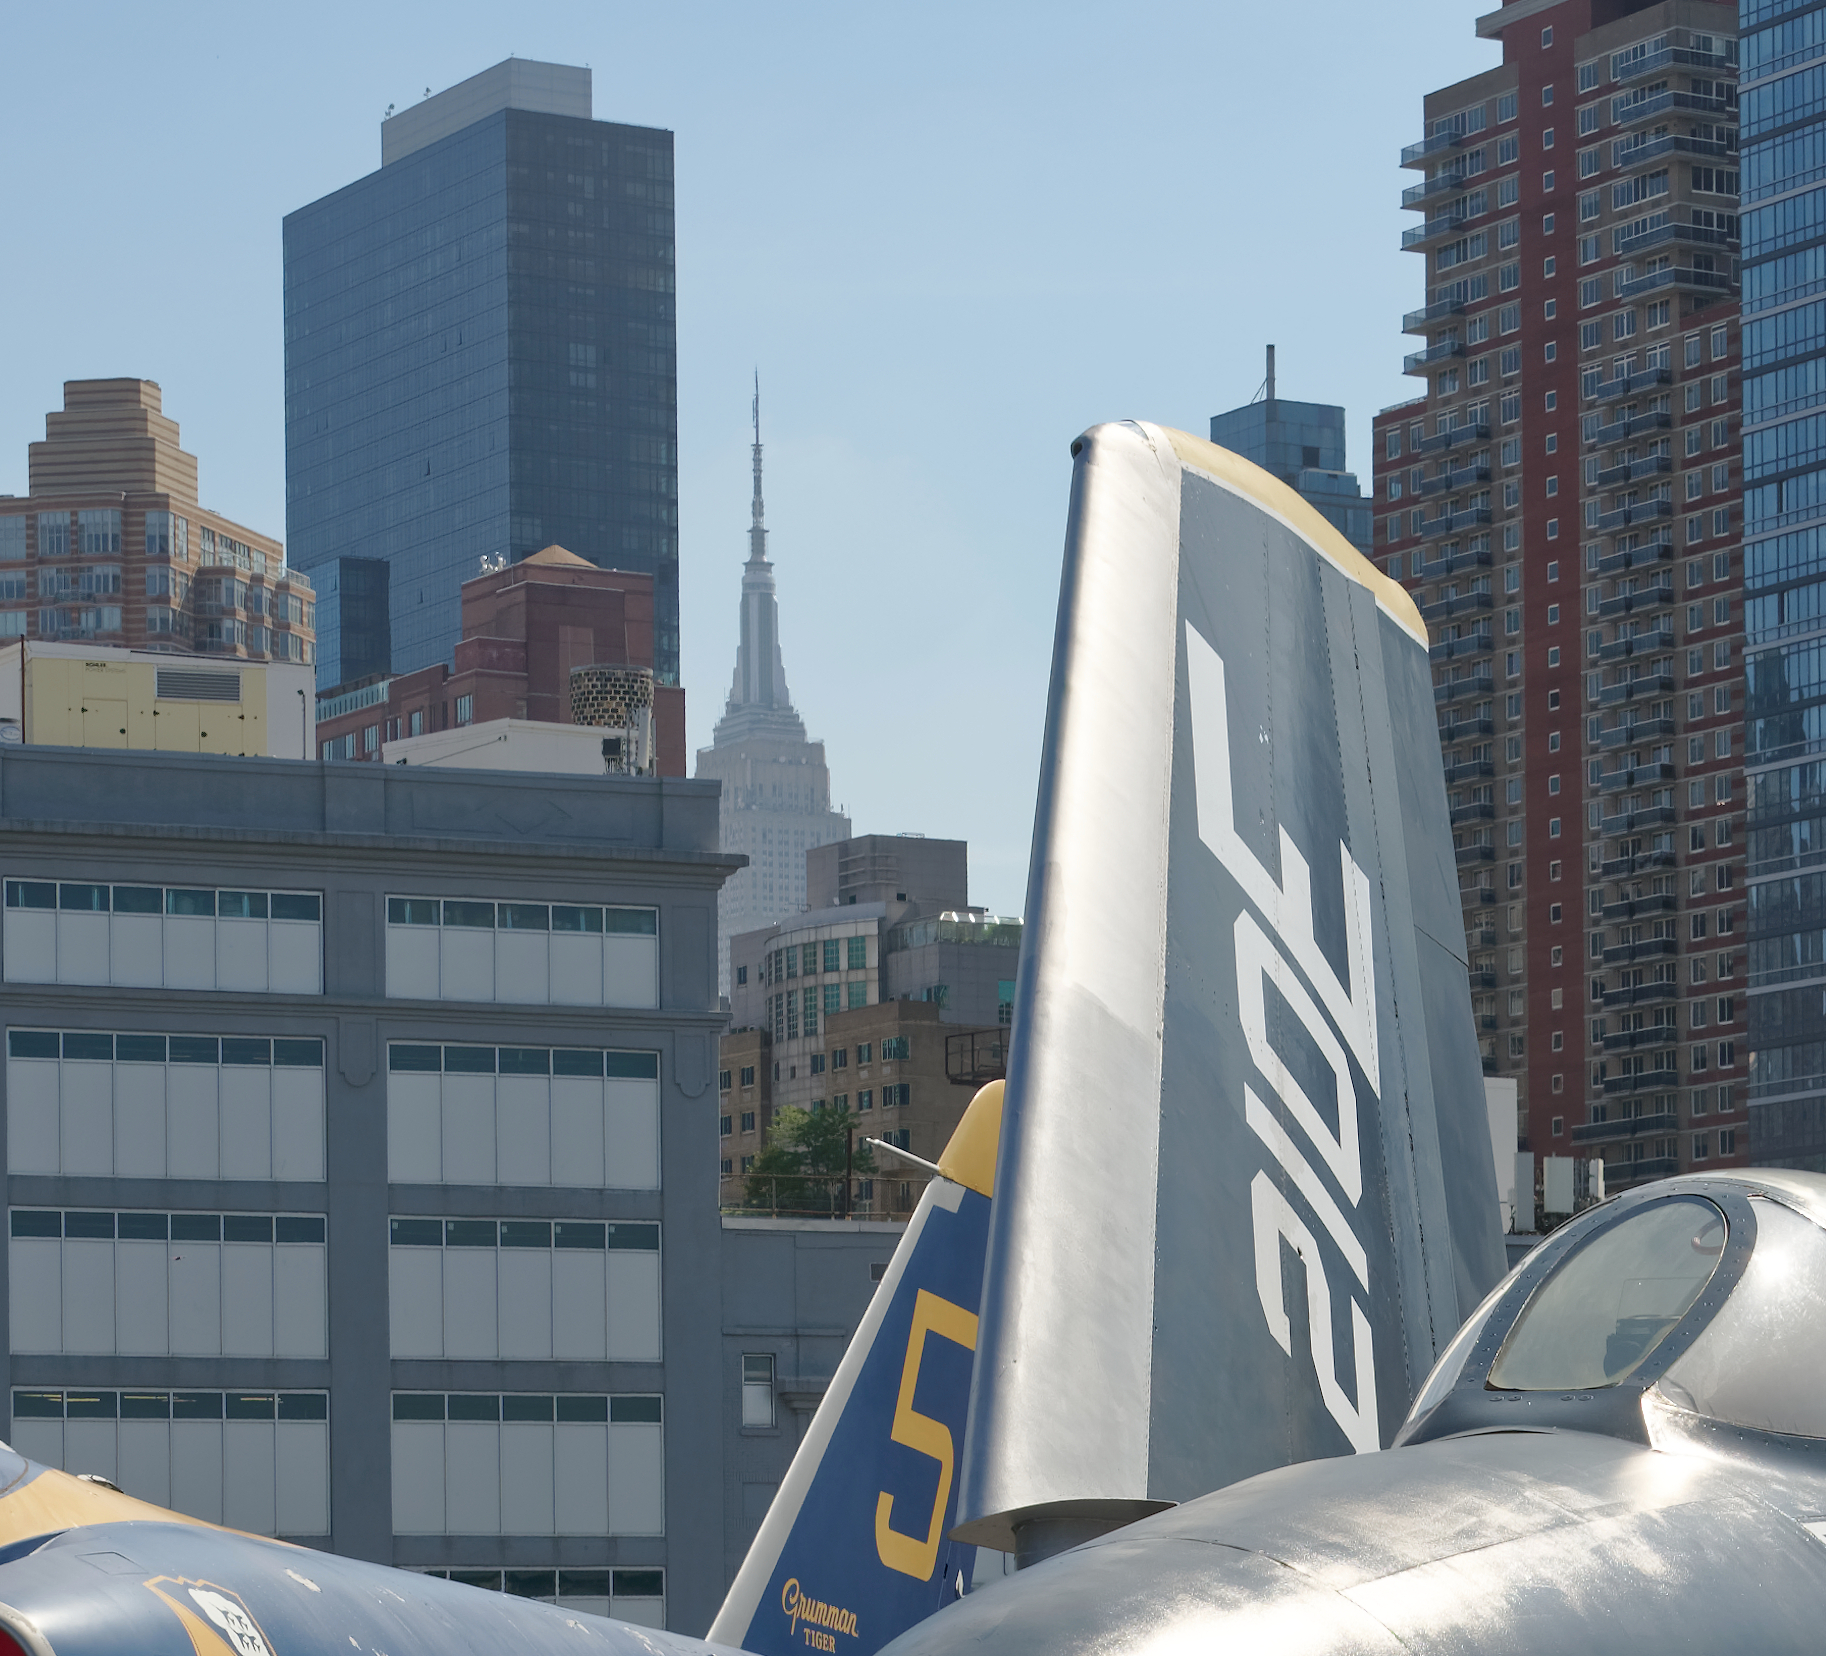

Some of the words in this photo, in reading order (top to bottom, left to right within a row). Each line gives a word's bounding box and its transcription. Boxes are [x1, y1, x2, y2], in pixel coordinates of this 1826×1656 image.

[875, 1288, 979, 1581] 5
[781, 1578, 859, 1638] Grumman
[803, 1628, 836, 1654] TIGER
